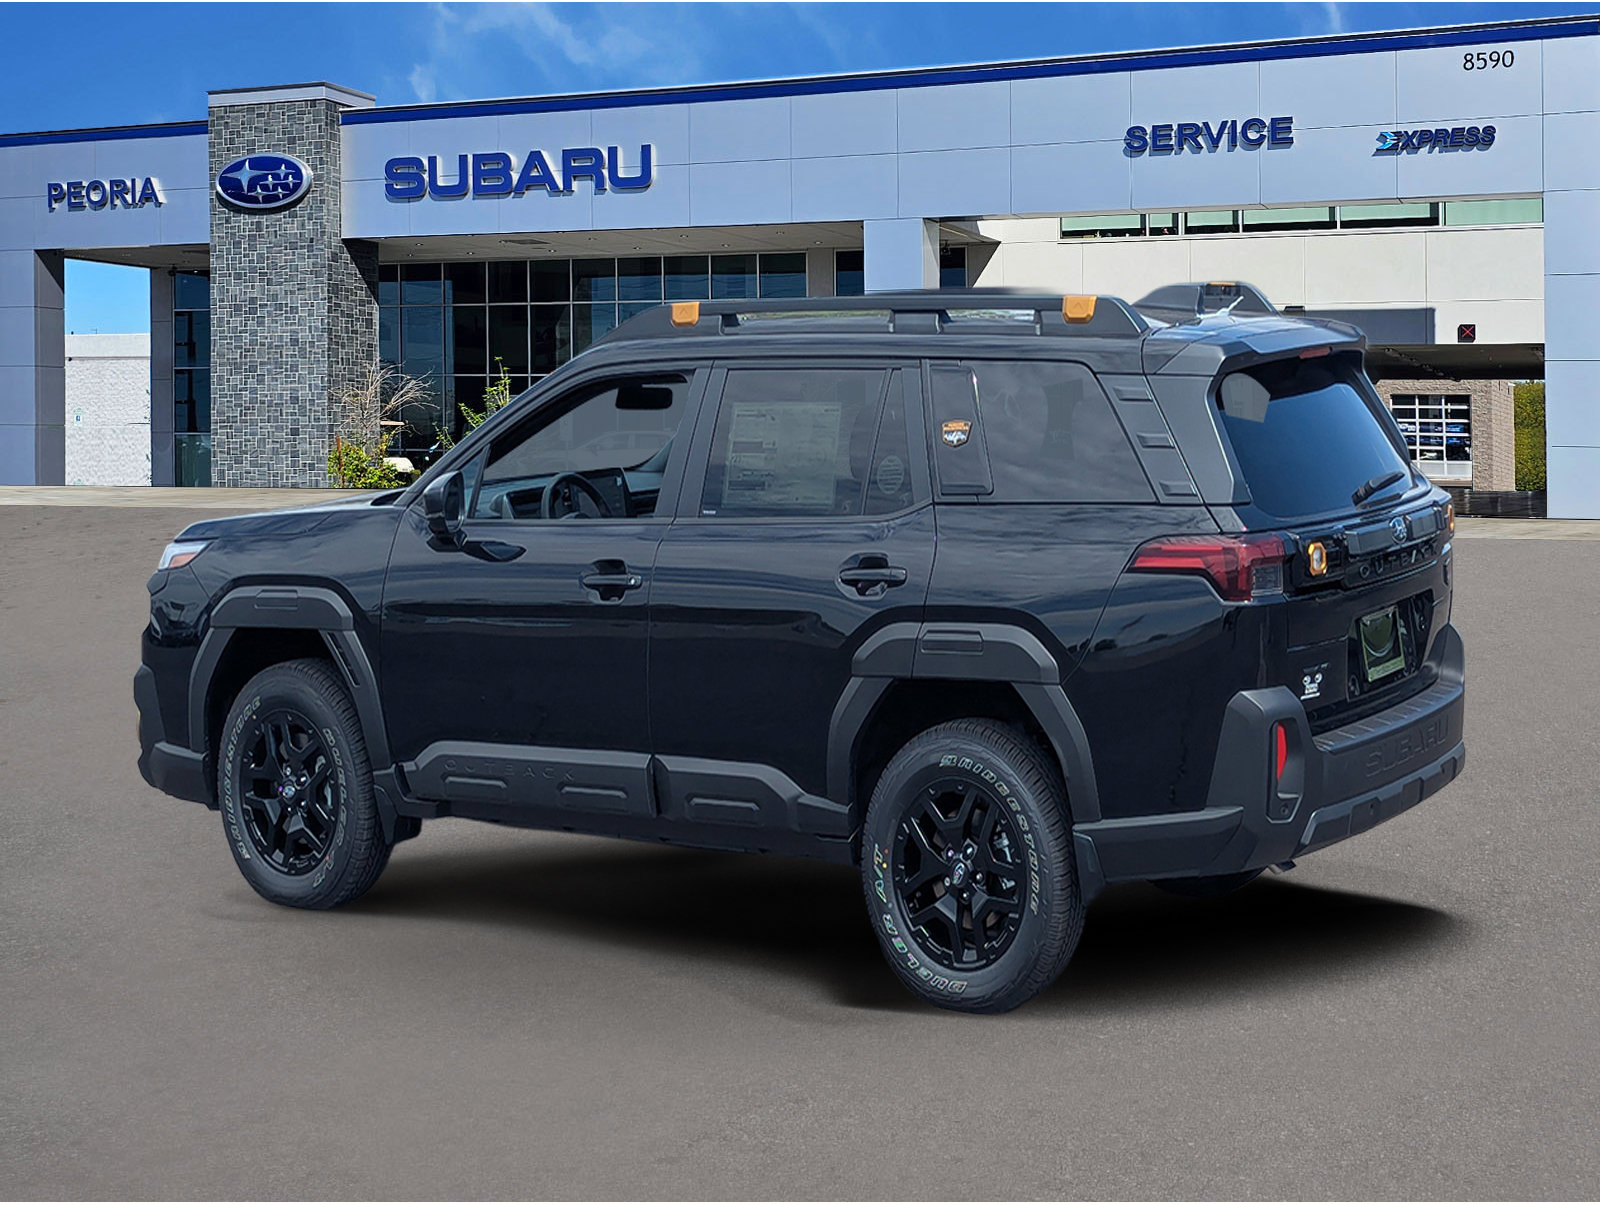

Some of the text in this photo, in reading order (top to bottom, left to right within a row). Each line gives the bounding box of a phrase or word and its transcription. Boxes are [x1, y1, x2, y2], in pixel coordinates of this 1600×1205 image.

[1463, 50, 1514, 71] 8590
[1124, 116, 1295, 153] SERVICE
[1375, 125, 1497, 152] EXPRESS
[384, 143, 652, 201] SUBARU
[47, 177, 161, 210] PEORIA
[444, 759, 575, 782] OUTBACK
[939, 754, 1041, 915] BRIDGESTONE
[882, 912, 968, 994] DUELER
